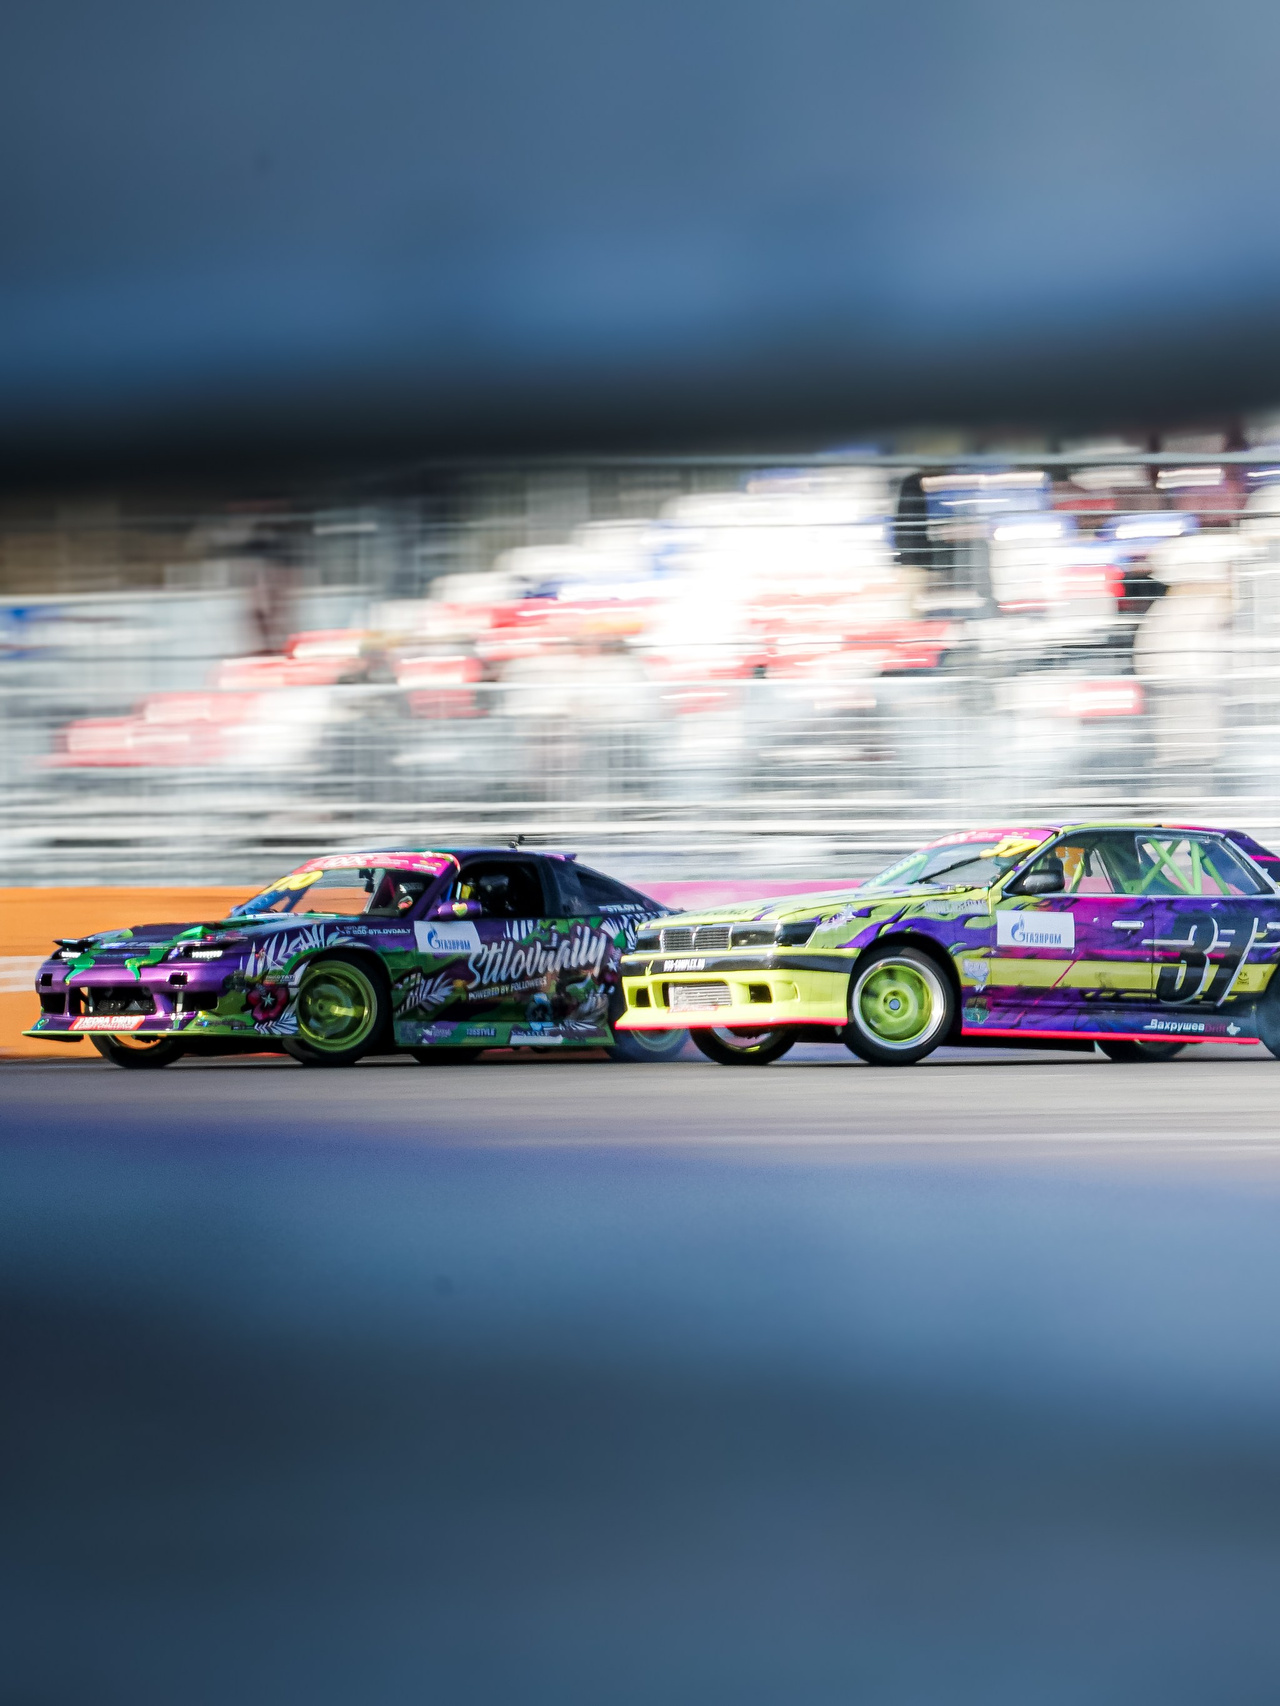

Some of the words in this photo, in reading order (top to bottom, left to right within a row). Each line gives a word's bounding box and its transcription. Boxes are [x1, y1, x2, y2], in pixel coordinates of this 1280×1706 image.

[469, 986, 500, 1000] POWERED
[500, 984, 509, 994] BY
[510, 976, 548, 992] FOLLOWERS
